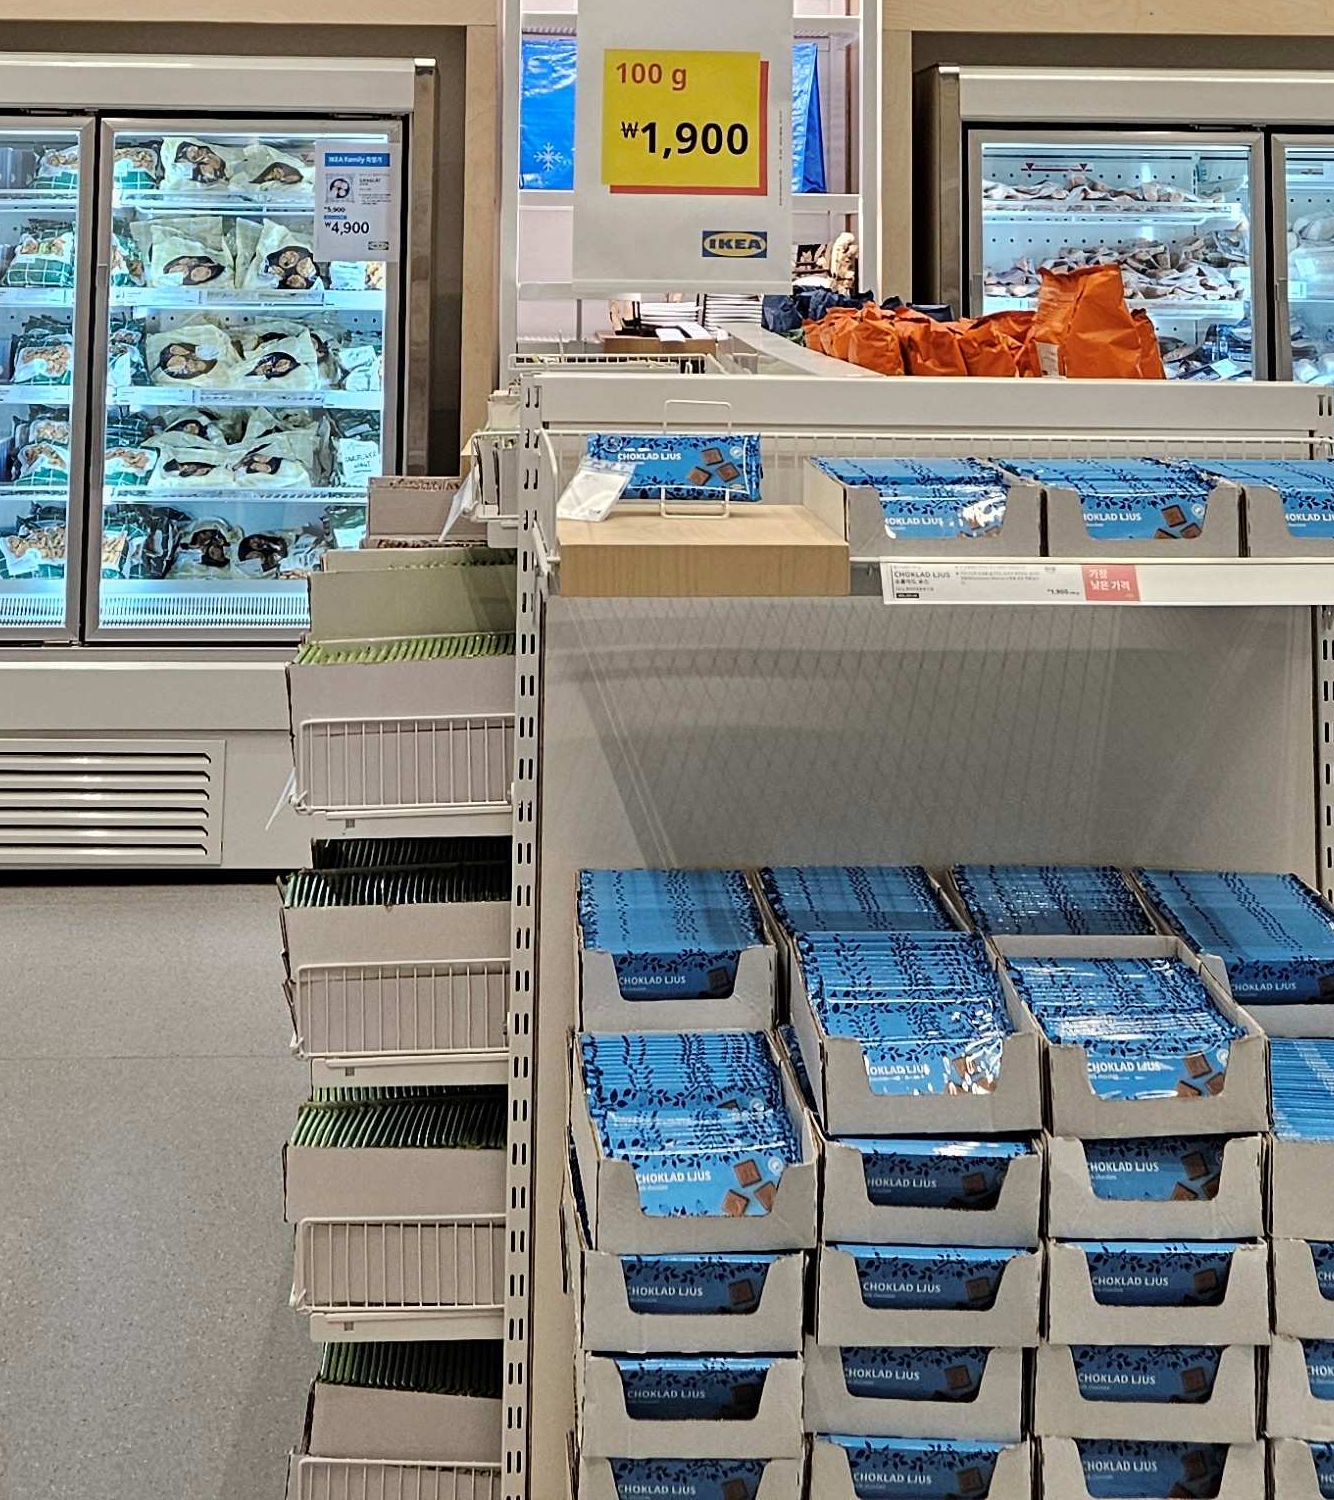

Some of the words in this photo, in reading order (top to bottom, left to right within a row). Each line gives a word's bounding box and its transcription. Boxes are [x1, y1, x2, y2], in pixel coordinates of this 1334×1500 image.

[616, 63, 663, 85] 100
[671, 67, 688, 92] g
[620, 121, 749, 159] ₩1,900
[709, 238, 762, 250] IKEA
[618, 453, 658, 461] CHOKLAD
[1119, 513, 1141, 522] LJUS
[618, 976, 663, 985] CHOKLAD
[665, 976, 686, 984] LJUS
[1136, 1162, 1159, 1172] LJUS
[636, 1173, 684, 1184] CHOKLAD
[686, 1172, 711, 1182] LJUS
[868, 1178, 910, 1187] HOKLAD
[913, 1179, 937, 1187] LJUS
[1093, 1277, 1141, 1286] CHOKLAD
[1144, 1277, 1168, 1286] LJUS
[678, 1287, 702, 1296] LJUS
[863, 1283, 915, 1292] CHOKLAD
[917, 1284, 941, 1293] LJUS
[895, 1370, 919, 1380] LJUS
[1078, 1374, 1128, 1384] CHOKLAD
[1131, 1375, 1155, 1384] LJUS
[627, 1390, 678, 1398] CHOKLAD
[681, 1390, 705, 1398] LJUS
[1134, 1461, 1157, 1471] LJUS
[854, 1473, 904, 1483] CHOKLAD
[906, 1474, 931, 1484] LJUS
[618, 1485, 669, 1494] CHOKLAD
[672, 1485, 696, 1494] LJUS
